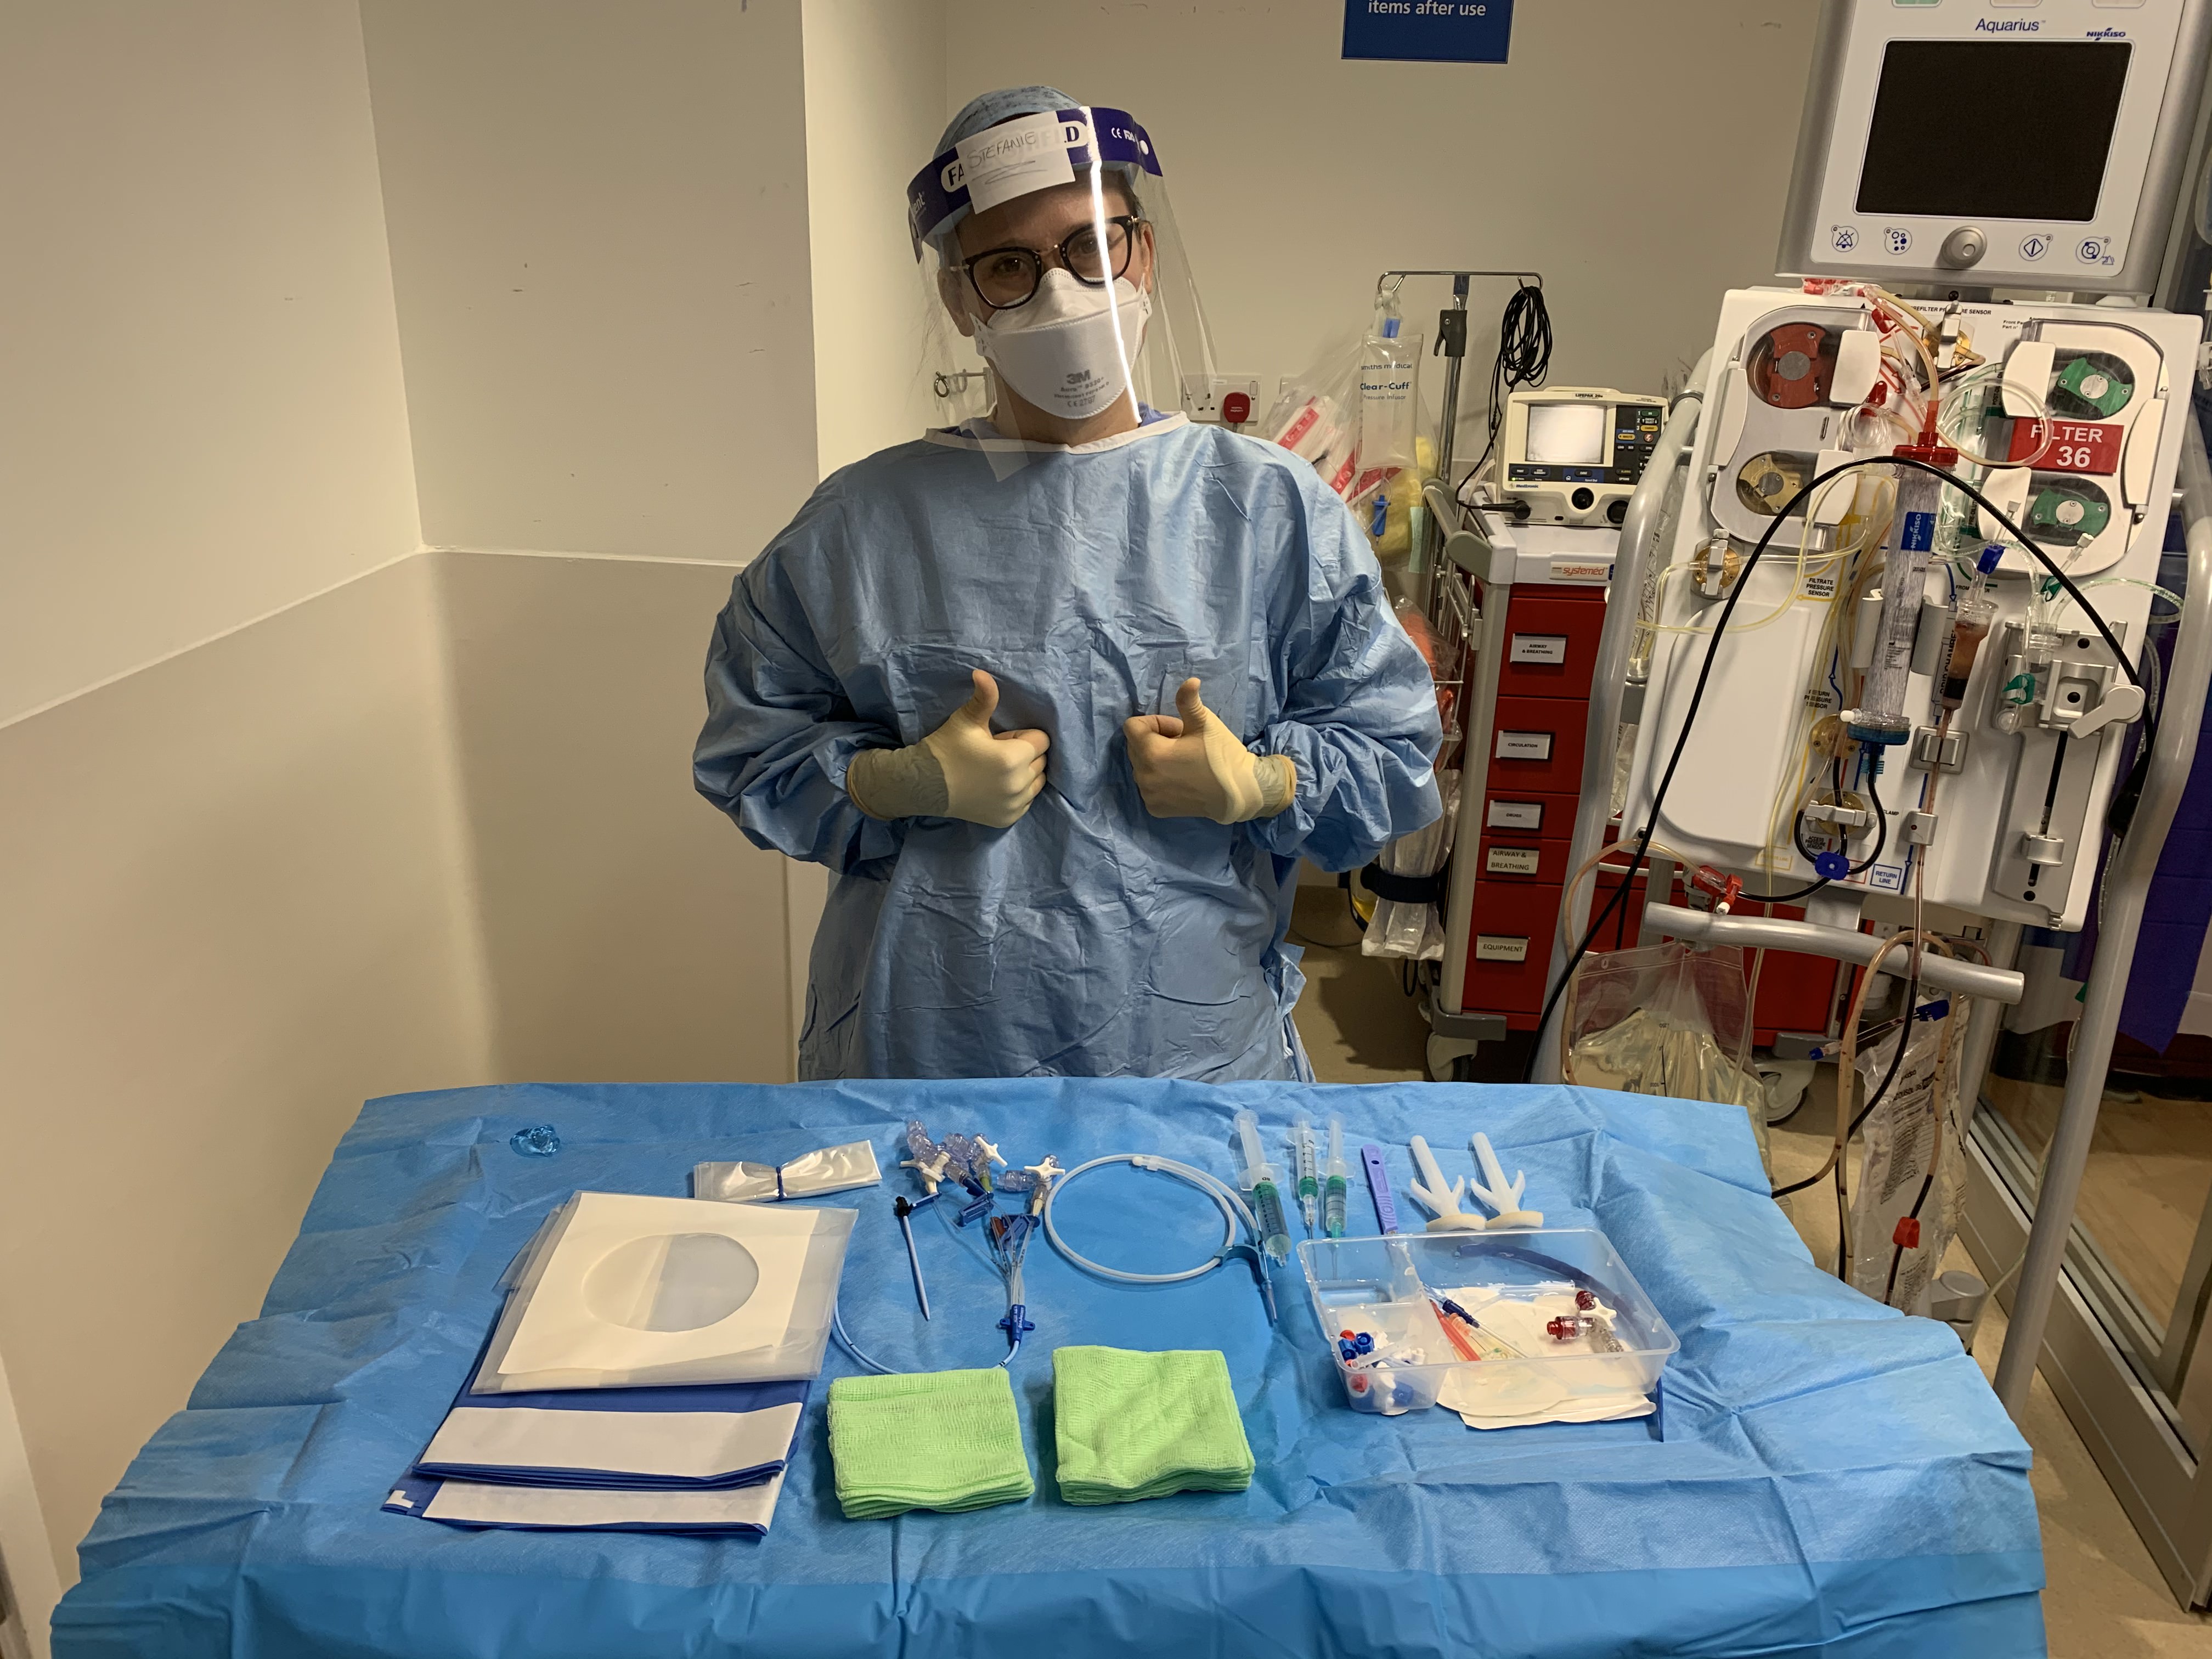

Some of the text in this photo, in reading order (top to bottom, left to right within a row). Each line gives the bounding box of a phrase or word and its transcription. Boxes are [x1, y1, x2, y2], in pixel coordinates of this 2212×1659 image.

[1368, 0, 1486, 16] items after use
[2086, 29, 2126, 39] NIKKISO
[967, 131, 1036, 168] STEFANIE
[1066, 369, 1091, 384] 3M
[1360, 382, 1409, 391] Clear-Cuff
[2031, 425, 2103, 443] FLTER
[2057, 446, 2091, 467] 36
[1910, 514, 1921, 549] NIKKISO
[1491, 862, 1530, 871] BREATHING
[1876, 871, 1897, 879] RETURN
[1483, 944, 1523, 952] EQUIPMENT
